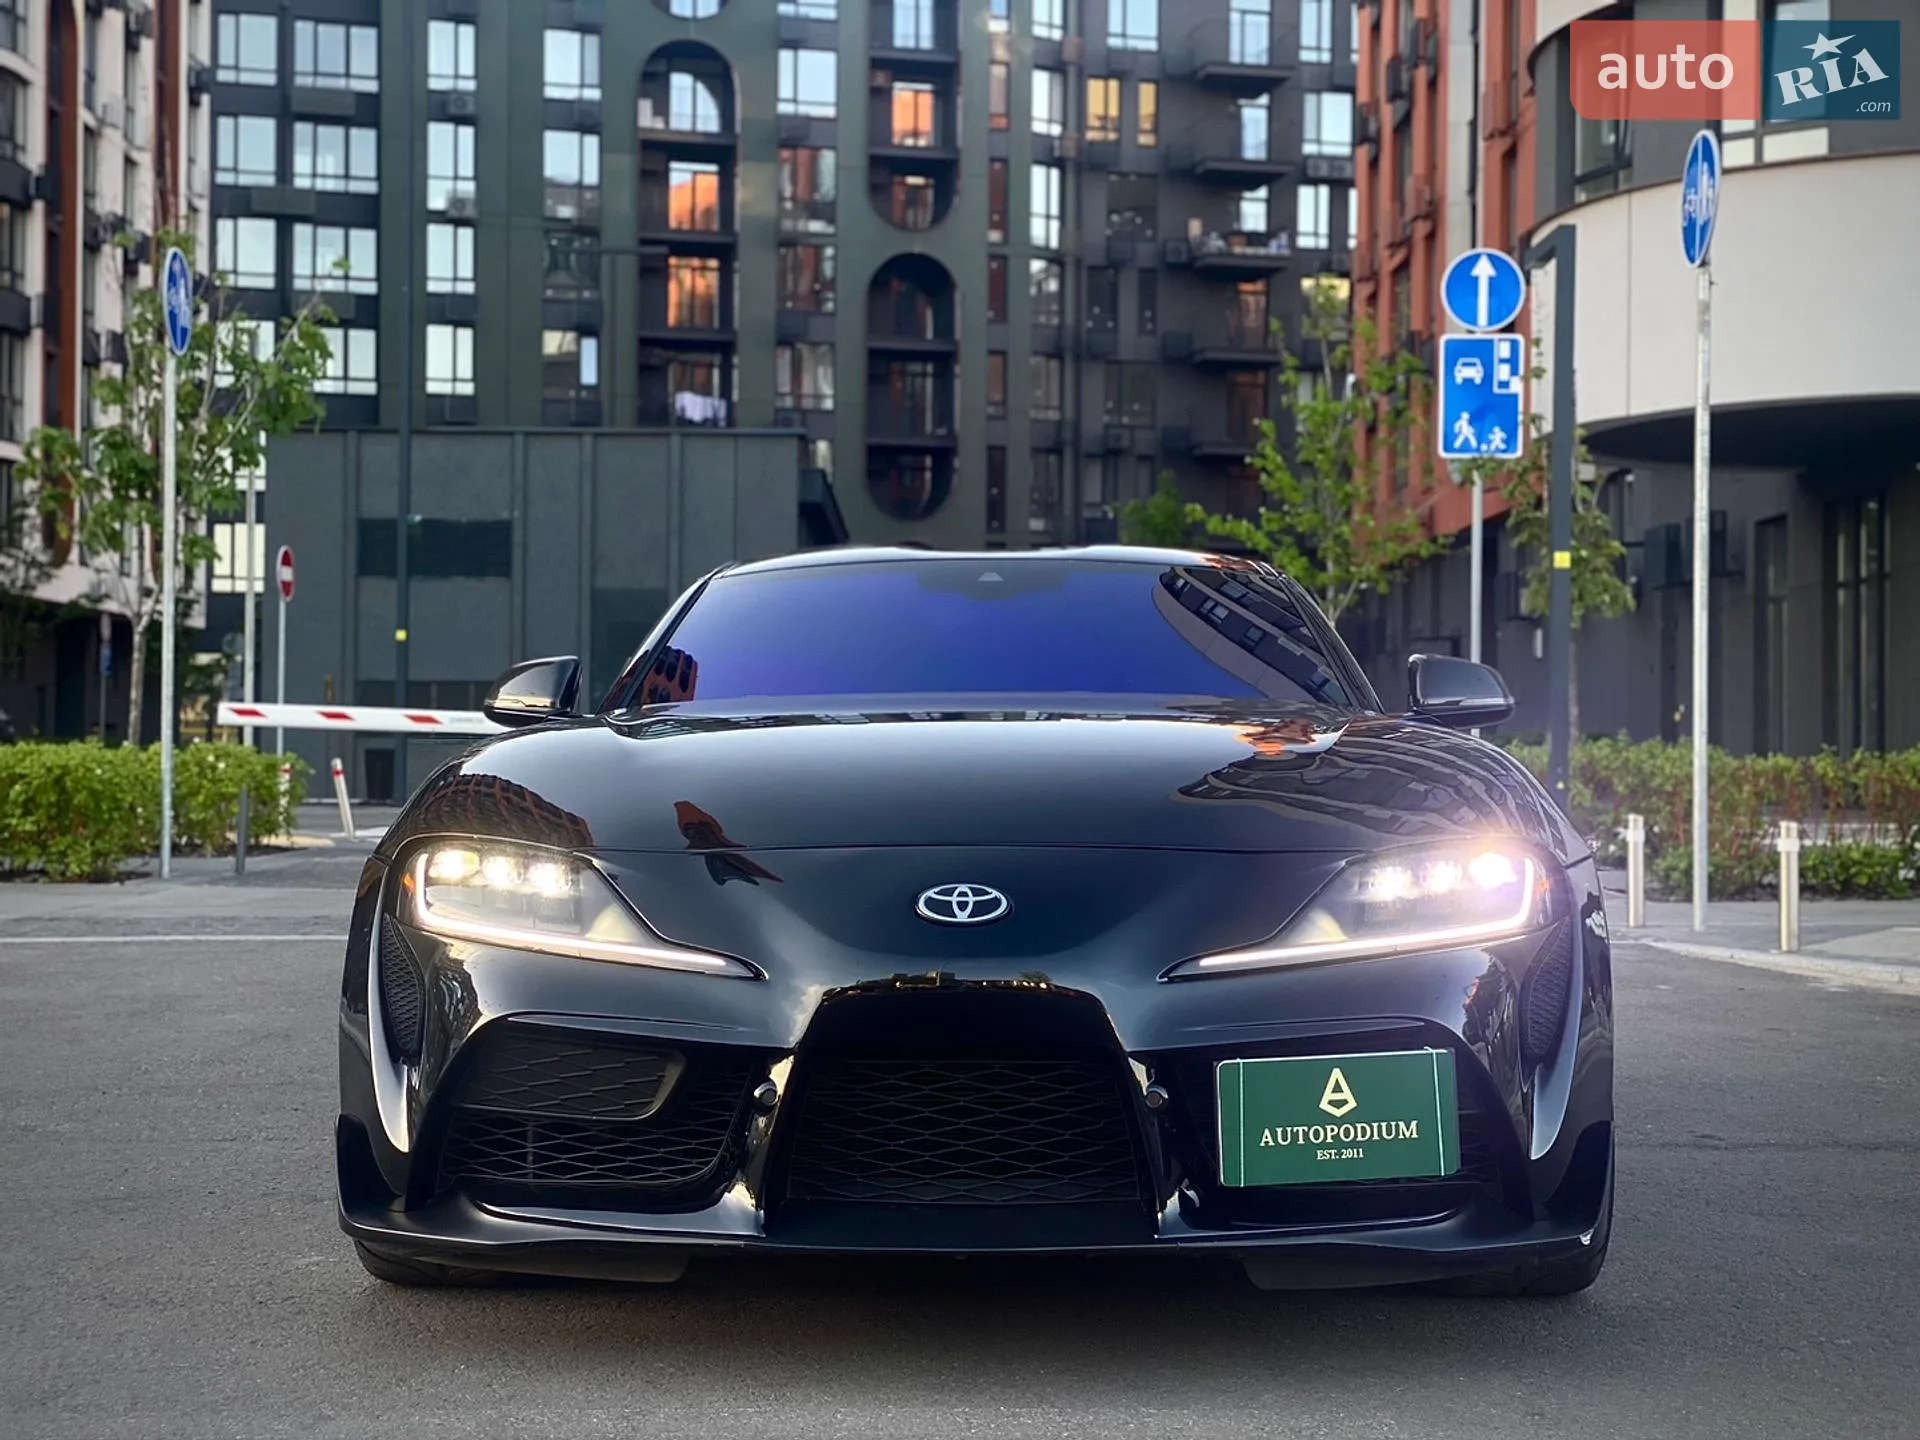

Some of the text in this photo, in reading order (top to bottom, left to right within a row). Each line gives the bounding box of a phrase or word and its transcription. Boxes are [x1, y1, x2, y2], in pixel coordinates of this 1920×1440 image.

[1259, 1120, 1419, 1147] AUTOPODIUM
[1316, 1148, 1364, 1161] EST. 2011
